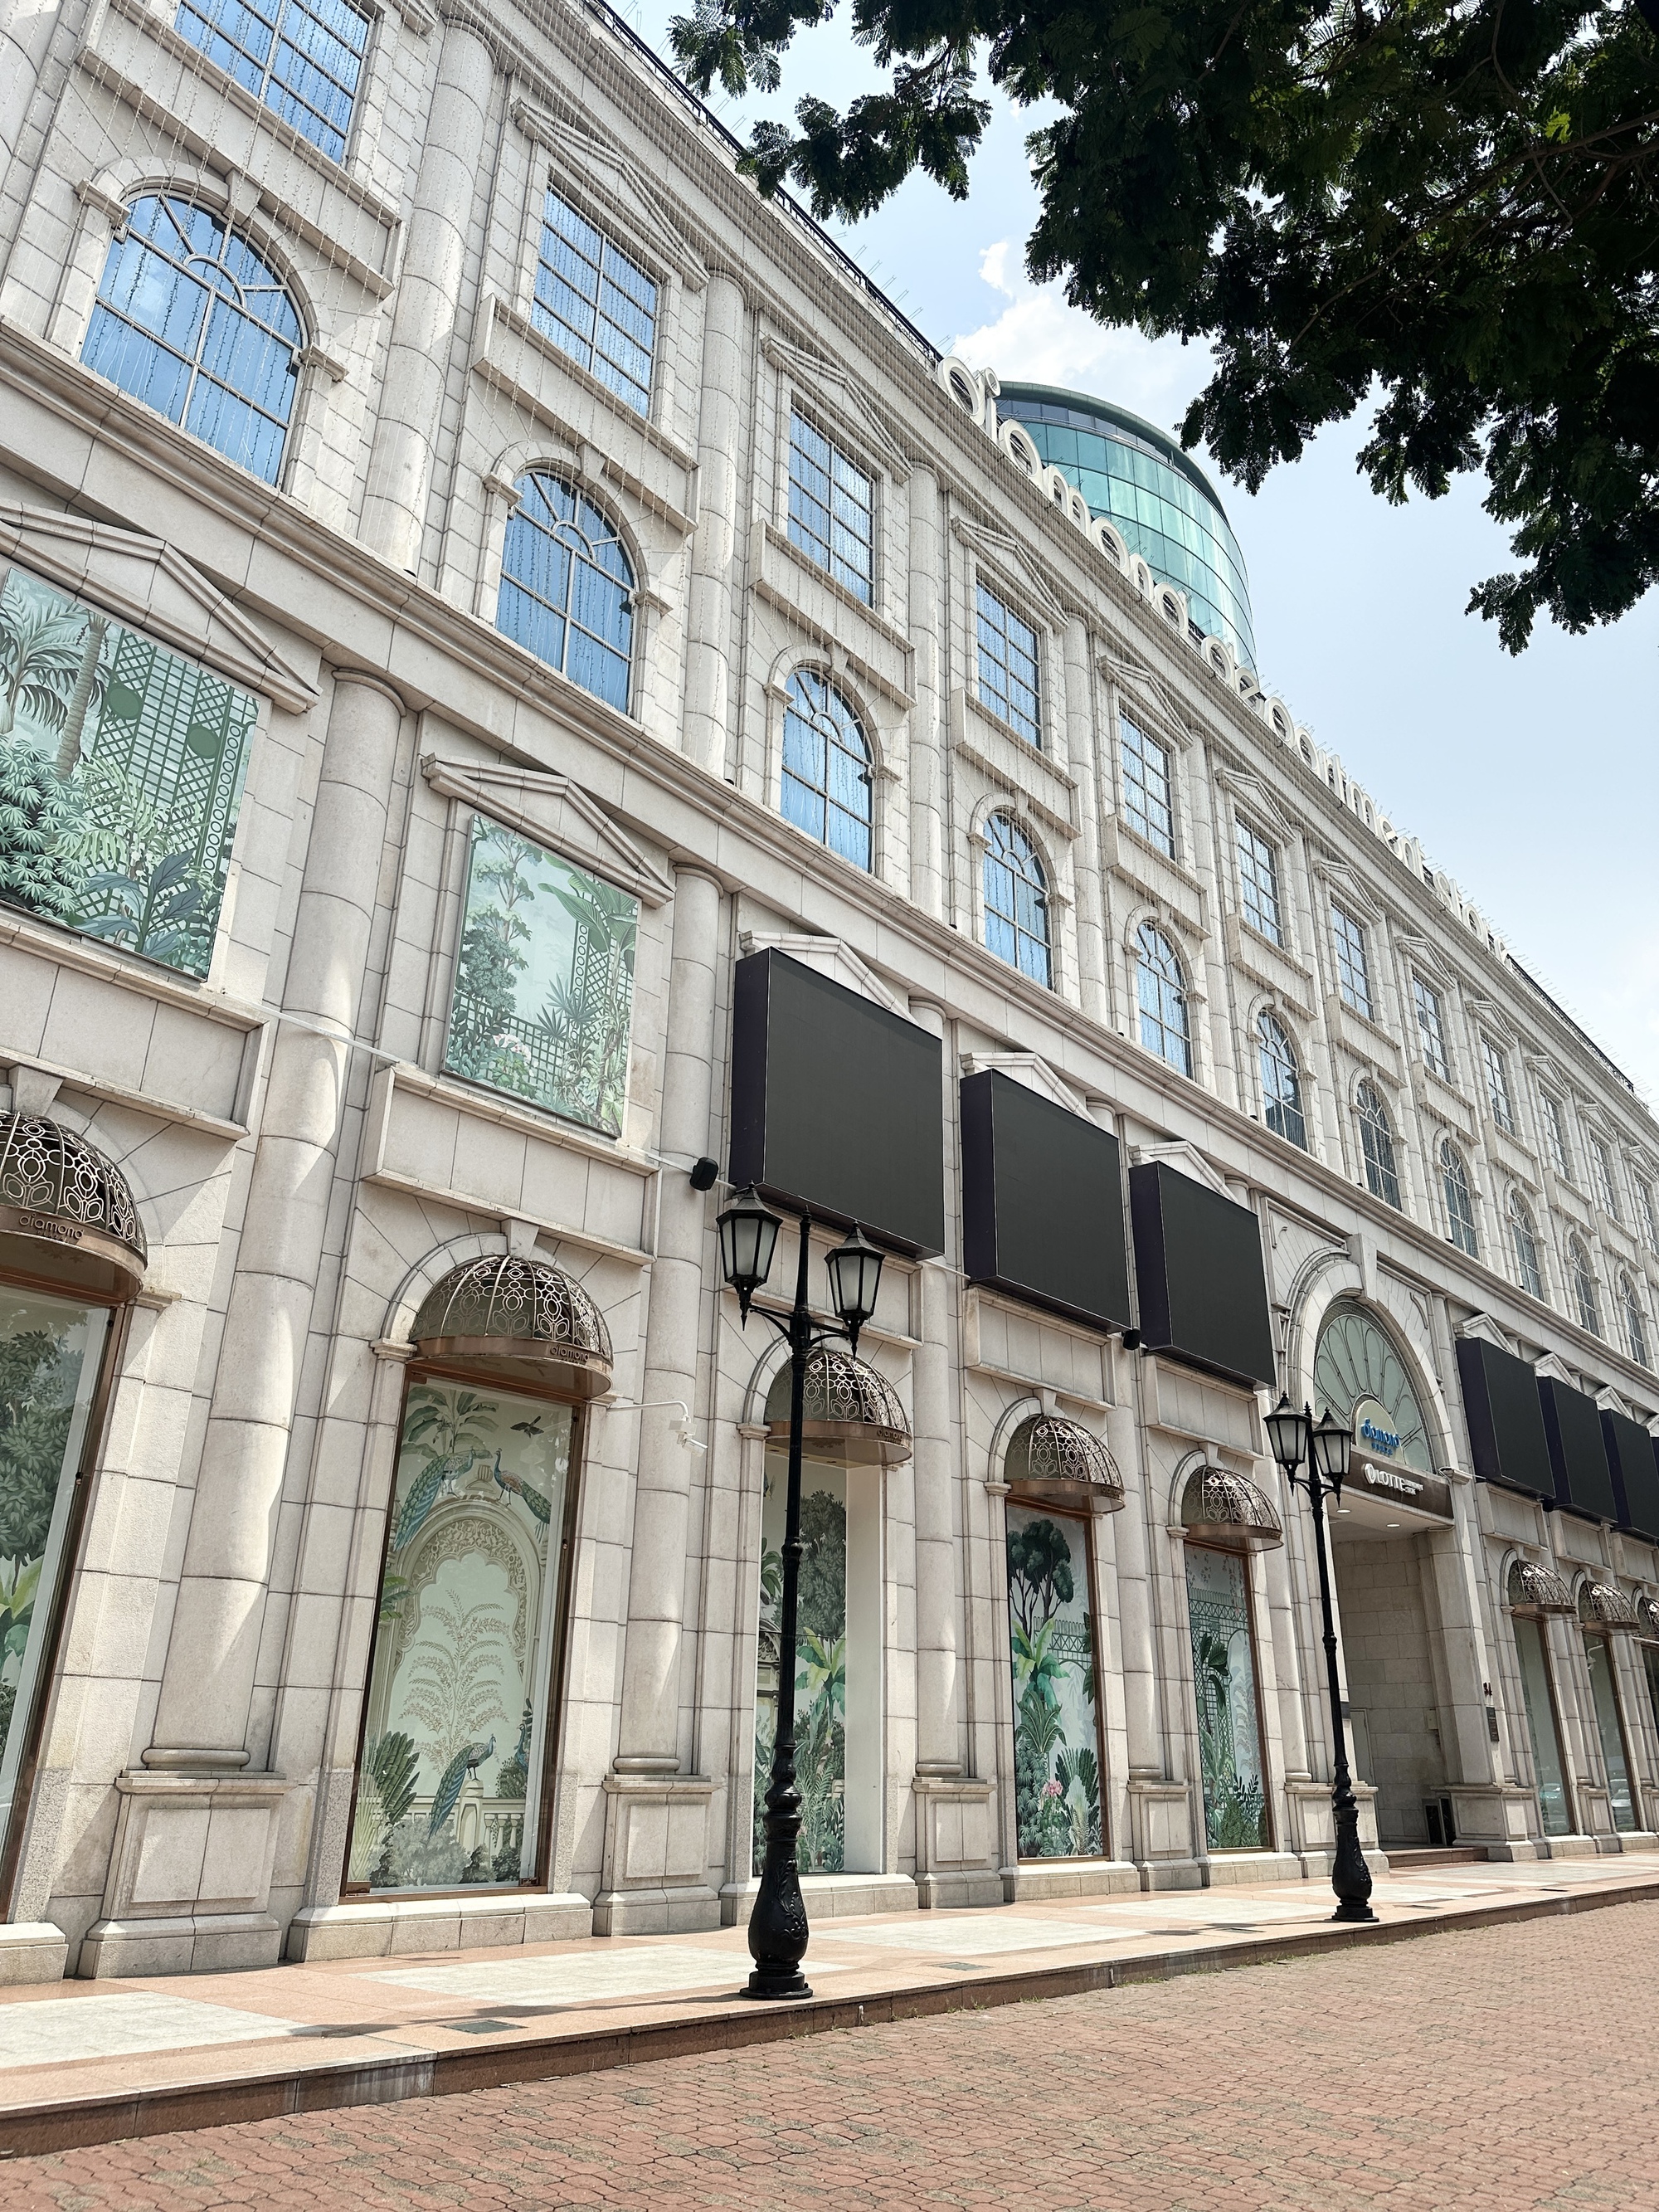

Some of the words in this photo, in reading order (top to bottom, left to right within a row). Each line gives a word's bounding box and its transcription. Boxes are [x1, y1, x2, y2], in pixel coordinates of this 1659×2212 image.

[937, 356, 1189, 640] diamond
[1201, 635, 1426, 884] department
[19, 1212, 85, 1240] diamond
[549, 1344, 590, 1362] diamond
[1360, 1417, 1400, 1448] diamond
[1374, 1469, 1406, 1492] LOTTE
